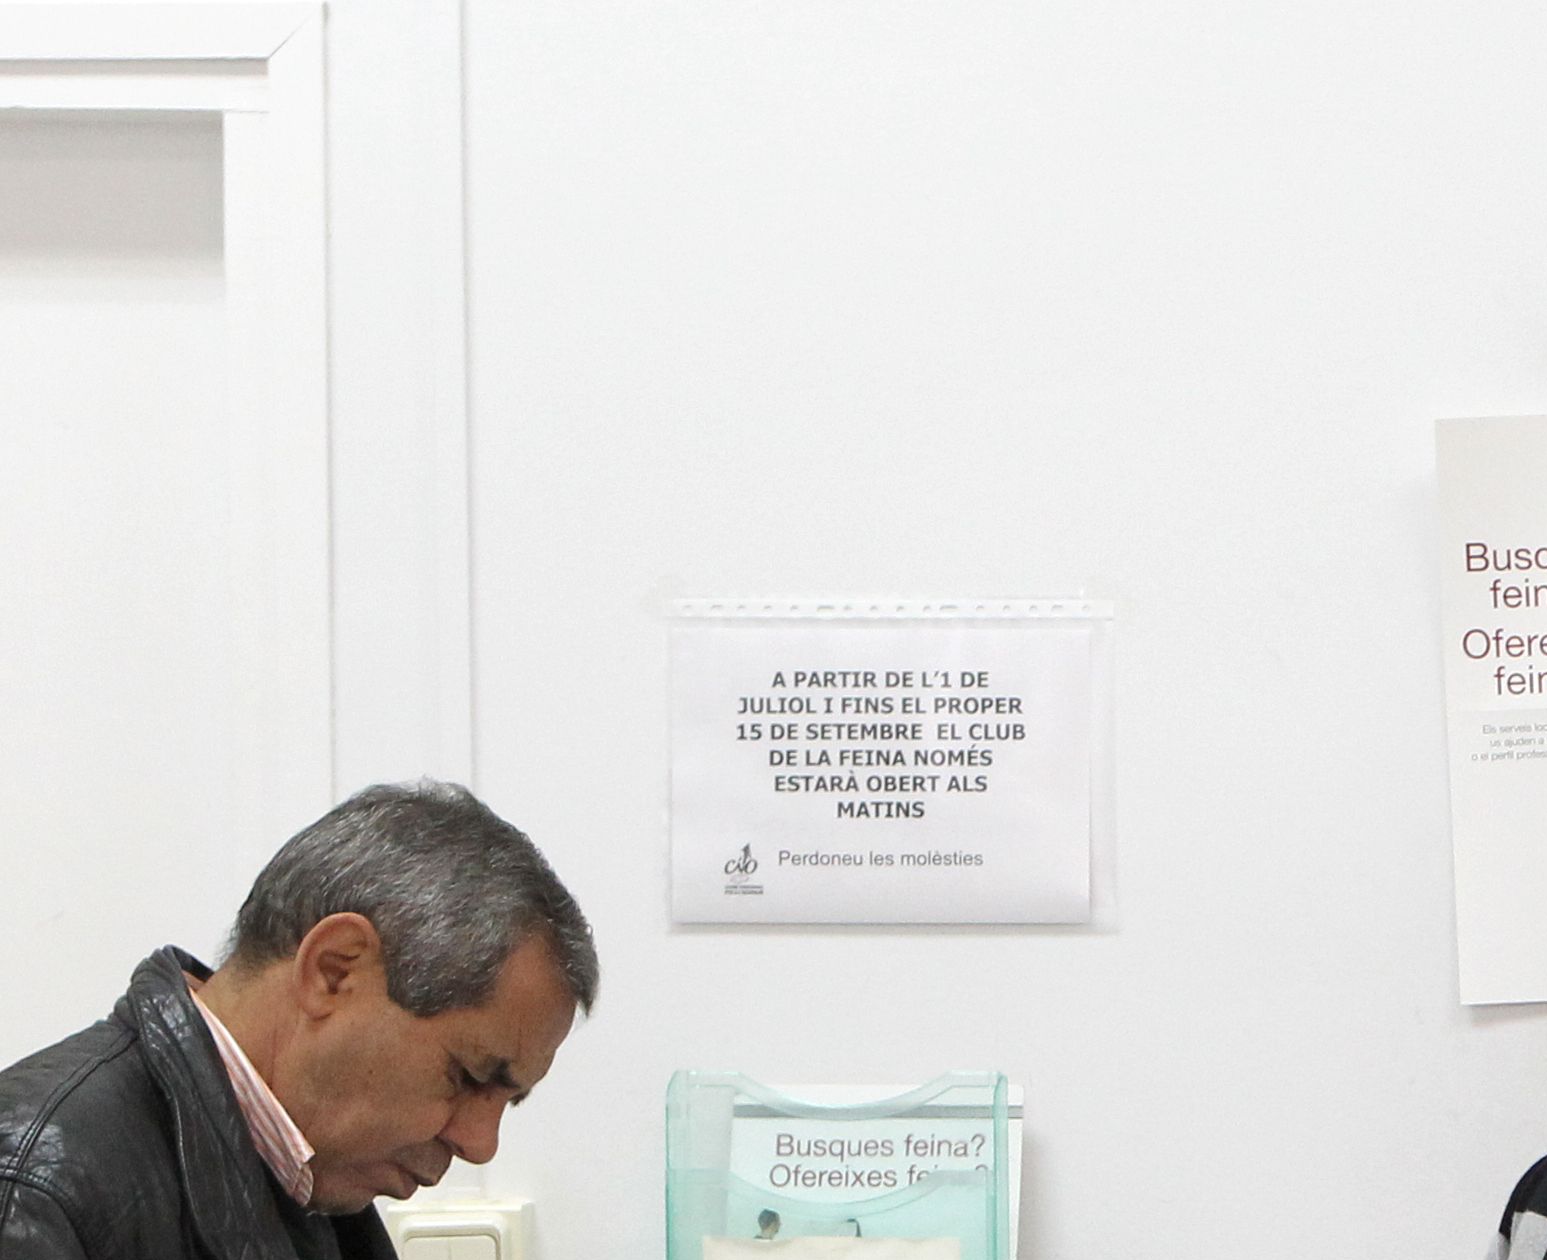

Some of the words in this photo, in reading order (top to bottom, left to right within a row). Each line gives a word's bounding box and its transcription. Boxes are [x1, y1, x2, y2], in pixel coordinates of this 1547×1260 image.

[772, 672, 786, 687] A
[794, 672, 876, 687] PARTIR
[886, 672, 913, 687] DE
[922, 671, 951, 687] L'1
[961, 672, 988, 688] DE
[738, 697, 816, 714] JULIOL
[825, 698, 832, 713] I
[842, 697, 893, 714] FINS
[902, 697, 925, 714] EL
[935, 698, 1022, 714] PROPER
[738, 724, 762, 740] 15
[771, 724, 798, 740] DE
[806, 723, 921, 740] SETEMBRE
[938, 724, 961, 740] EL
[969, 724, 1025, 740] CLUB
[1483, 724, 1496, 734] Els
[1500, 725, 1531, 734] serveis
[770, 750, 797, 766] DE
[806, 750, 831, 766] LA
[840, 750, 906, 766] FEINA
[914, 745, 992, 766] NOMÉS
[775, 771, 859, 792] ESTARÀ
[867, 776, 939, 792] OBERT
[948, 776, 987, 792] ALS
[838, 802, 924, 818] MATINS
[779, 850, 863, 866] Perdoneu
[870, 851, 894, 866] les
[901, 851, 983, 866] molèsties
[776, 1134, 893, 1161] Busques
[905, 1134, 985, 1157] feina?
[770, 1164, 897, 1187] Ofereixes
